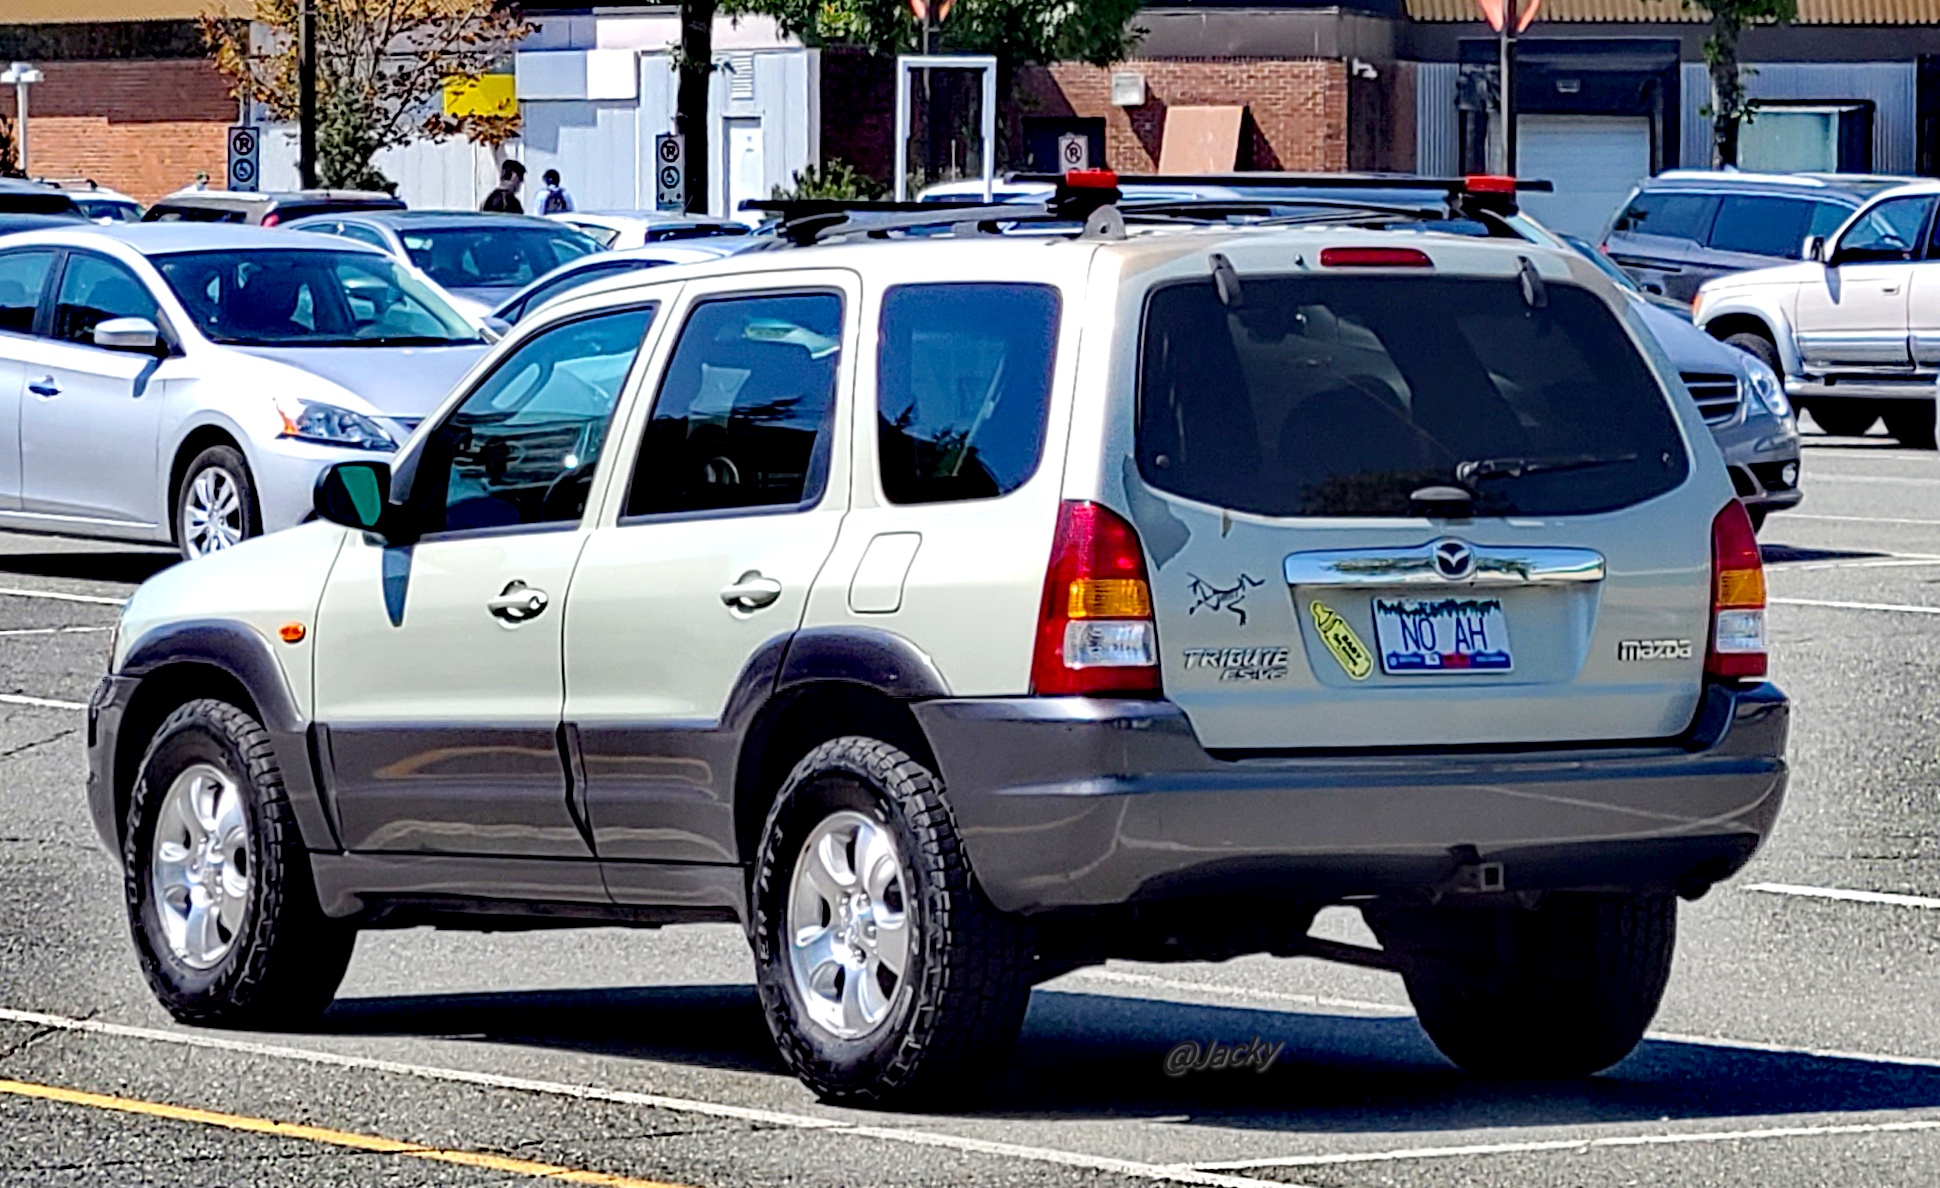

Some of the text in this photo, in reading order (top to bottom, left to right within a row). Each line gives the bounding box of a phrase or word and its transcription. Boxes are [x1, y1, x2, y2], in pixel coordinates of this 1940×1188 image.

[1400, 616, 1436, 652] NO
[1456, 616, 1488, 653] AH
[1182, 647, 1290, 670] TRIBUTE
